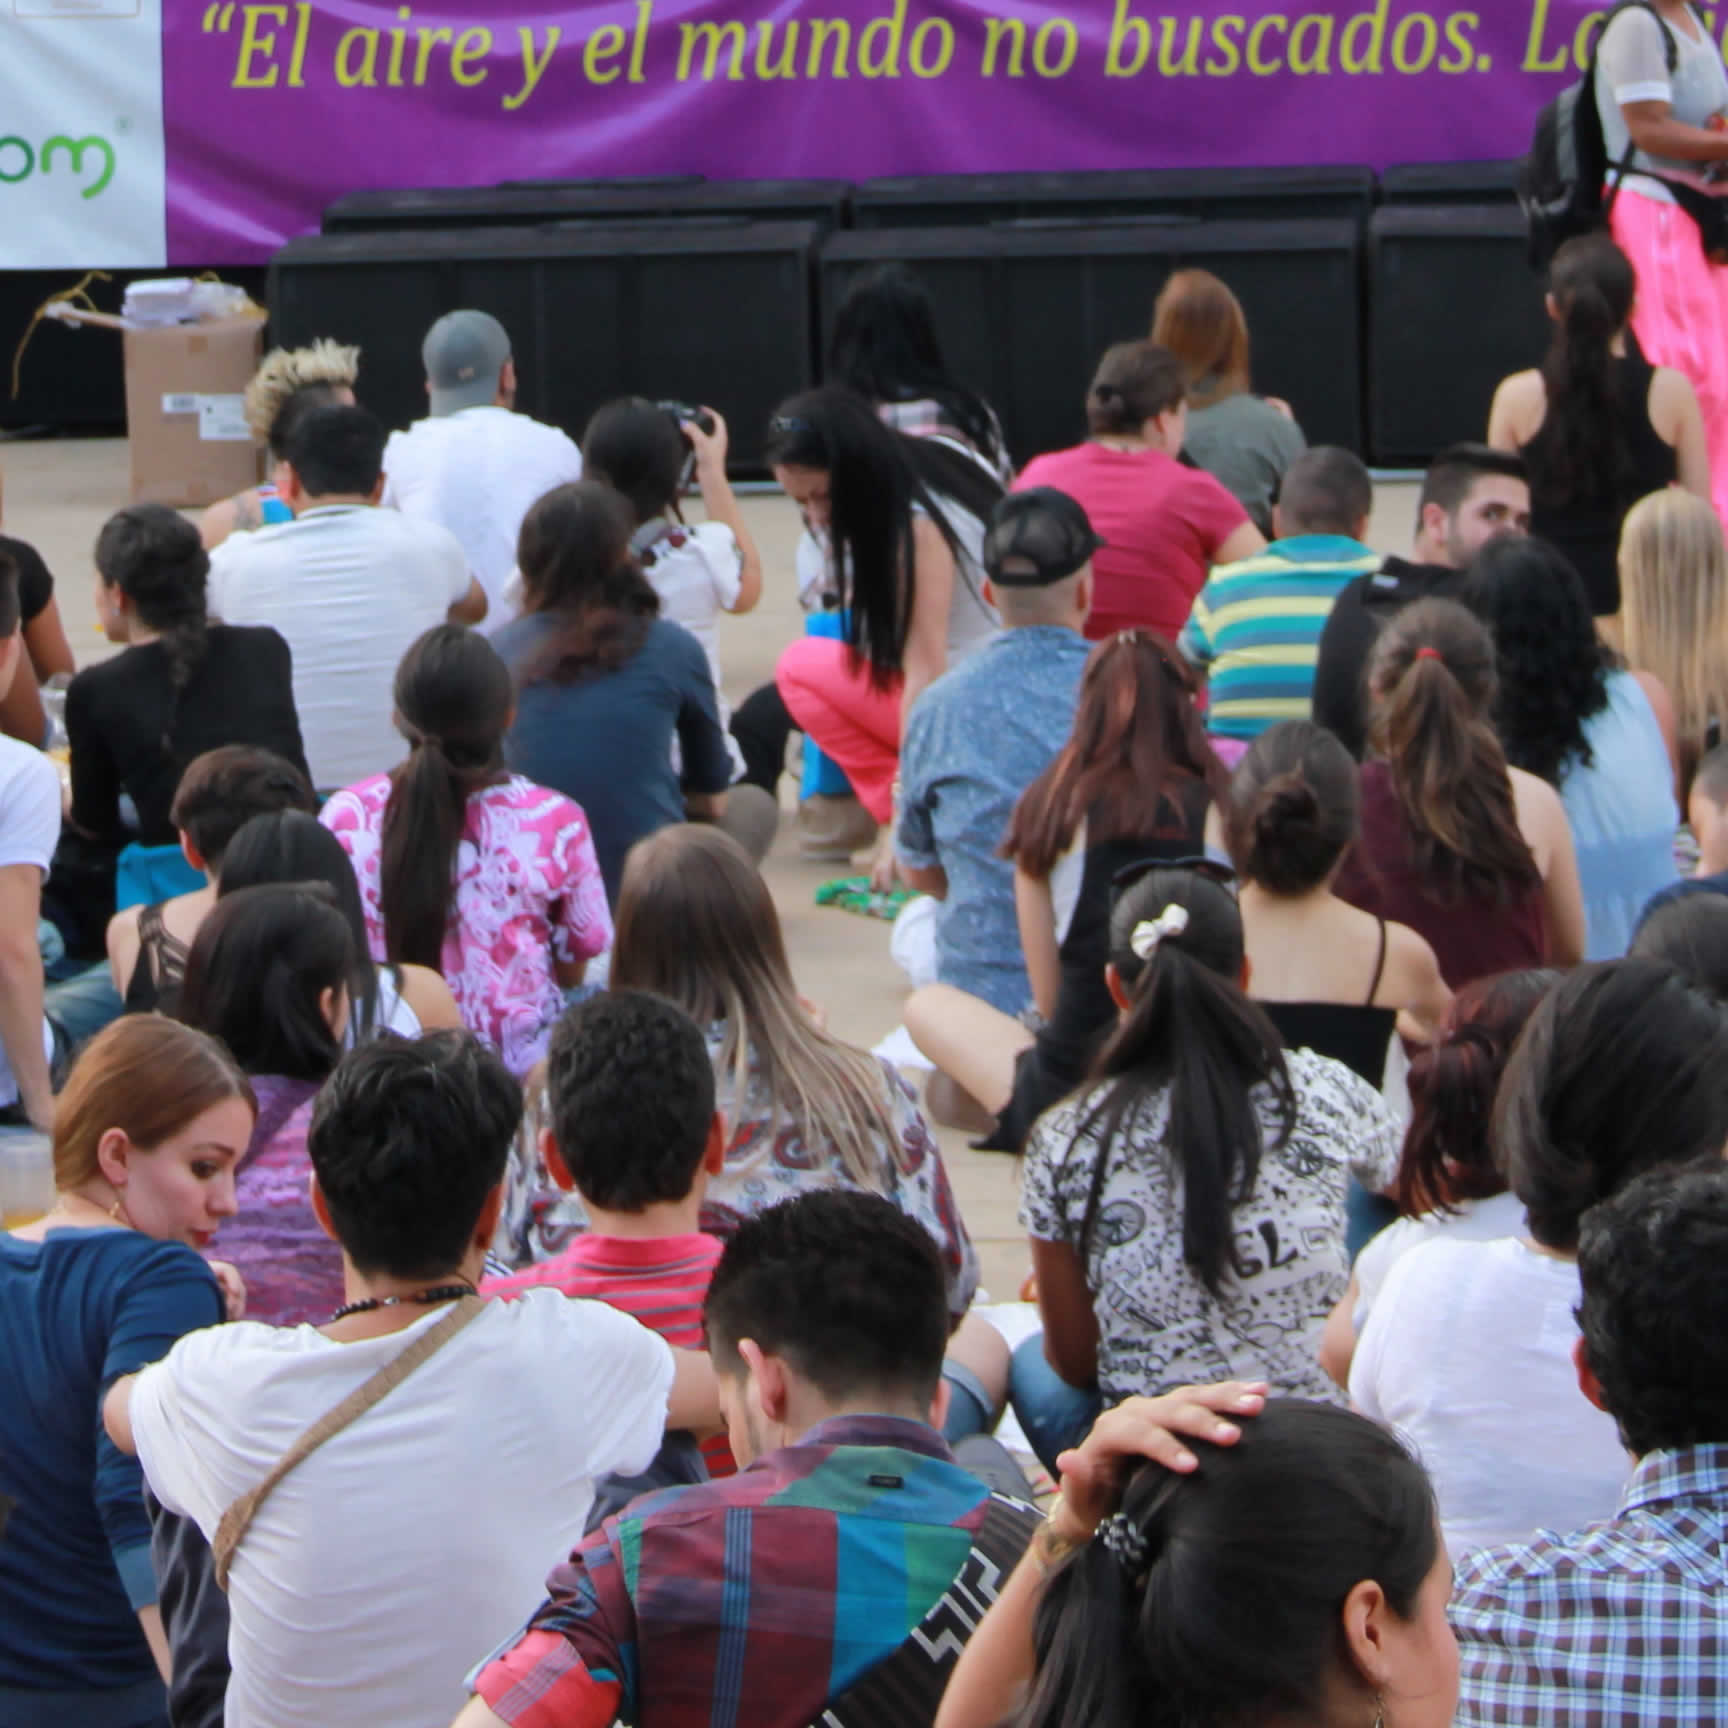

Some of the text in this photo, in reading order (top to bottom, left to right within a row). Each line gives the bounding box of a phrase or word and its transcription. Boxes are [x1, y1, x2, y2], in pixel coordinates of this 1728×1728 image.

[201, 0, 312, 89] “El
[333, 7, 492, 88] aire
[502, 18, 561, 111] y
[980, 16, 1078, 79] no
